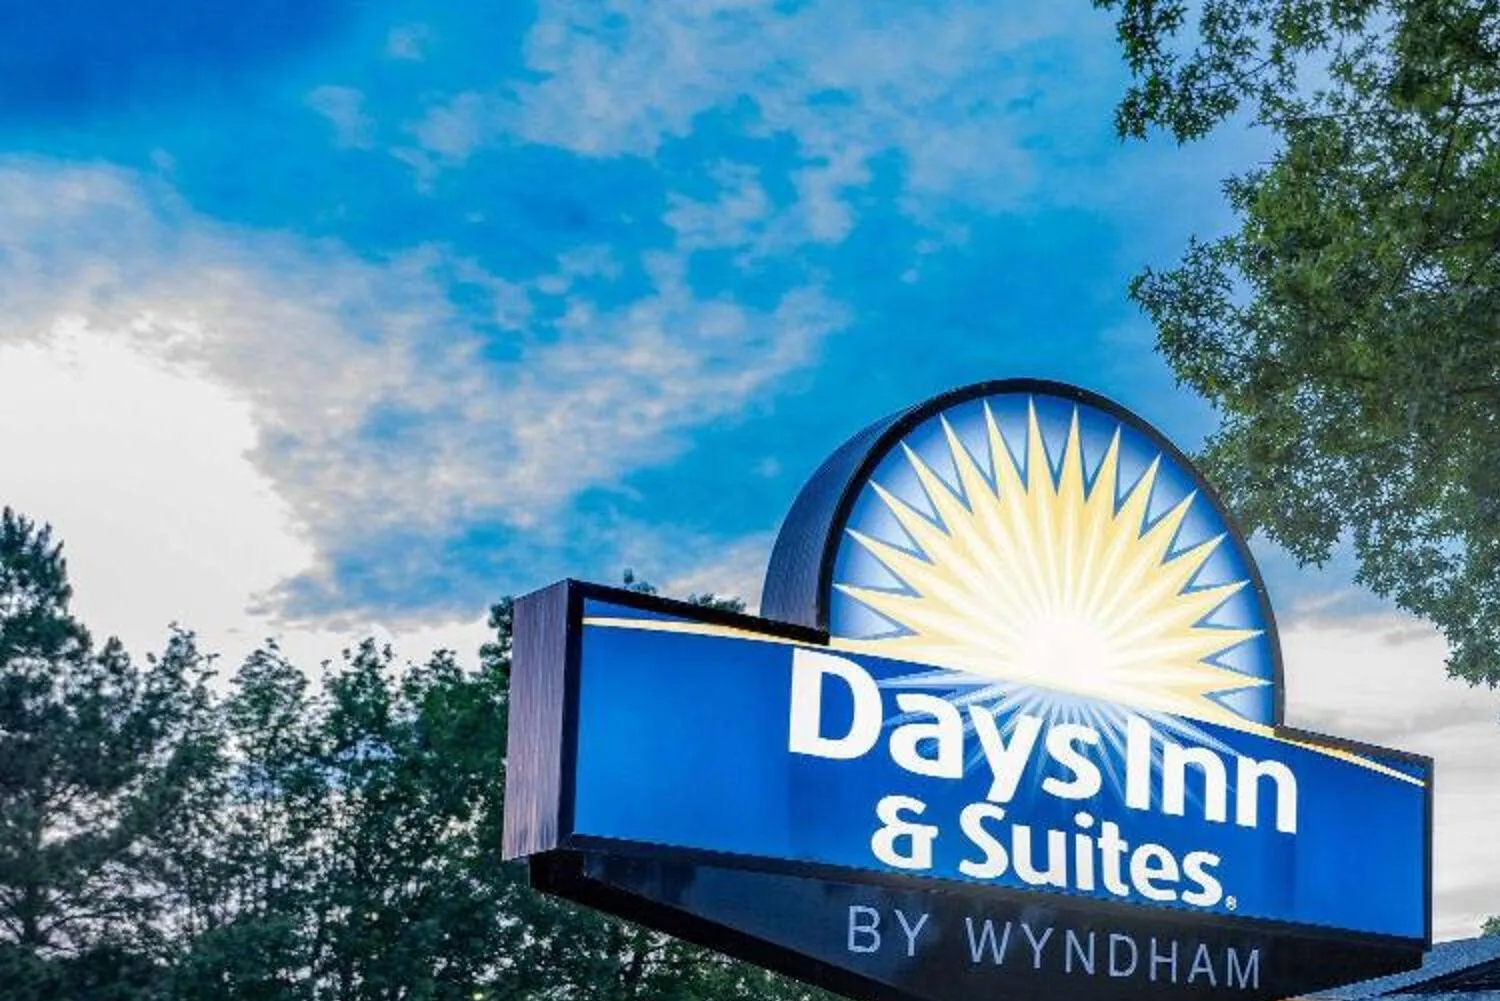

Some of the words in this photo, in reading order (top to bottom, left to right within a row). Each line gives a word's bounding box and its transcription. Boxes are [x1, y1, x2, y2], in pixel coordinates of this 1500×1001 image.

[788, 647, 1102, 803] Days
[1125, 713, 1297, 834] Inn
[870, 795, 939, 869] &
[847, 904, 929, 957] BY
[964, 916, 1261, 990] WYNDHAM
